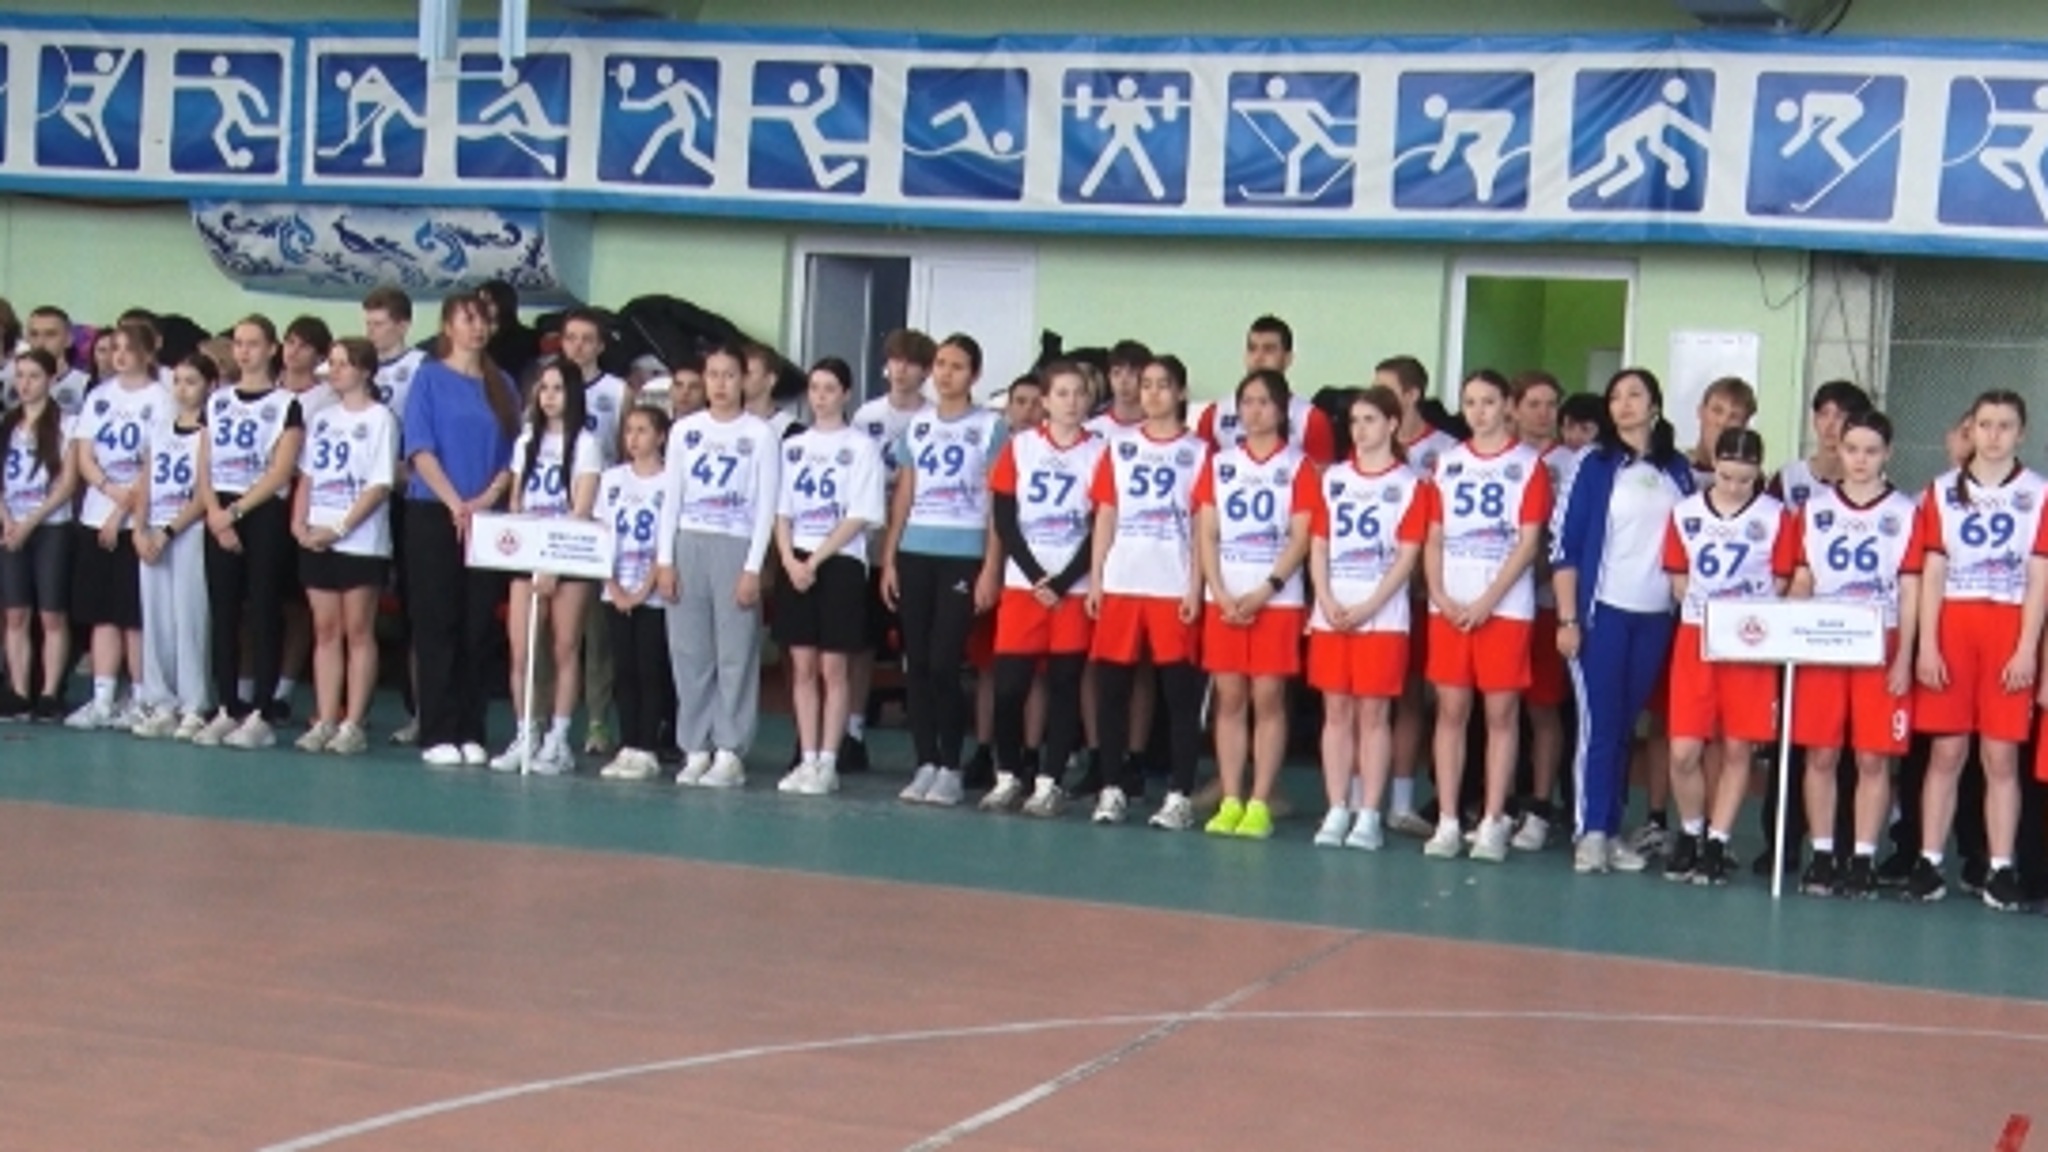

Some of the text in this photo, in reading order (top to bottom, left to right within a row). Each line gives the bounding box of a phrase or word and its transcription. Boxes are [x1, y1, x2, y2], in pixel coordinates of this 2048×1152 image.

[98, 422, 140, 451] 40
[214, 418, 257, 449] 38
[6, 449, 42, 483] 37
[154, 453, 192, 484] 36
[314, 441, 349, 470] 39
[691, 455, 737, 487] 47
[917, 444, 964, 476] 49
[529, 464, 562, 496] 50
[794, 467, 836, 499] 46
[1028, 472, 1076, 505] 57
[1129, 466, 1176, 498] 59
[1226, 489, 1275, 521] 60
[1455, 483, 1504, 517] 58
[615, 509, 654, 542] 48
[1337, 504, 1380, 538] 56
[1960, 512, 2015, 547] 69
[1696, 543, 1749, 577] 67
[1827, 537, 1879, 571] 66
[1892, 709, 1908, 740] 9
